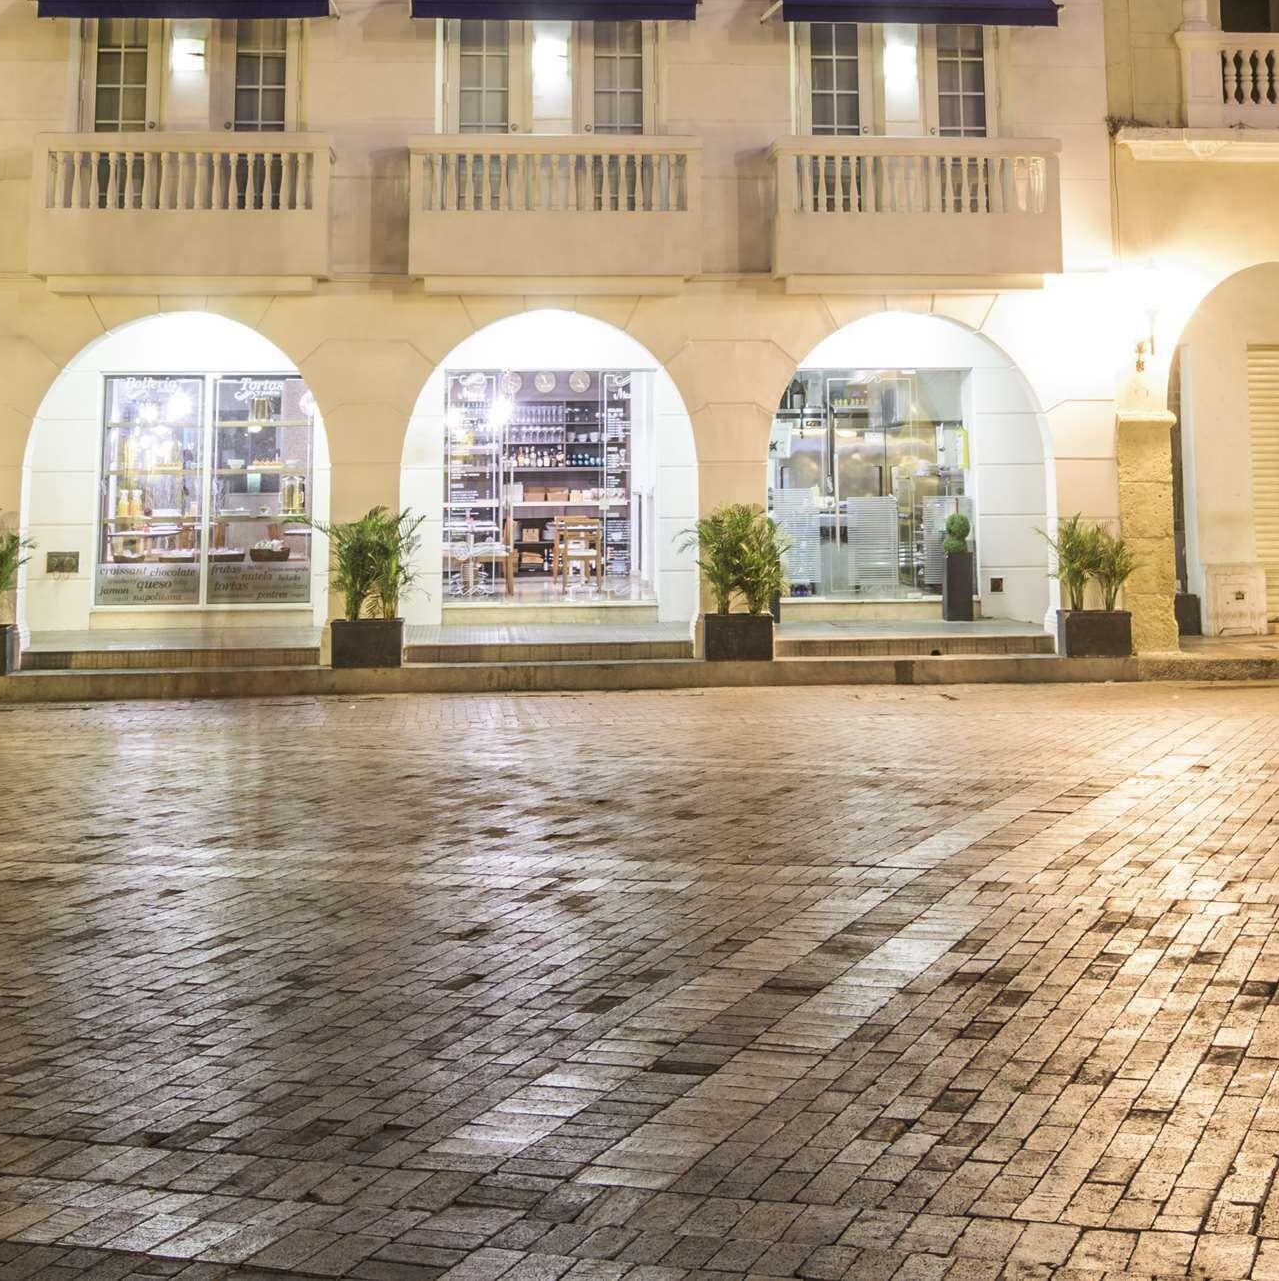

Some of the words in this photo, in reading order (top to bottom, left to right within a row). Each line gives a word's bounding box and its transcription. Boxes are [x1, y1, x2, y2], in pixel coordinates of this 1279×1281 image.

[240, 377, 284, 391] Tortas
[99, 565, 147, 576] croissant
[150, 567, 196, 578] chocolate
[211, 564, 241, 576] frutas
[136, 579, 172, 591] queso
[214, 581, 249, 592] tortas
